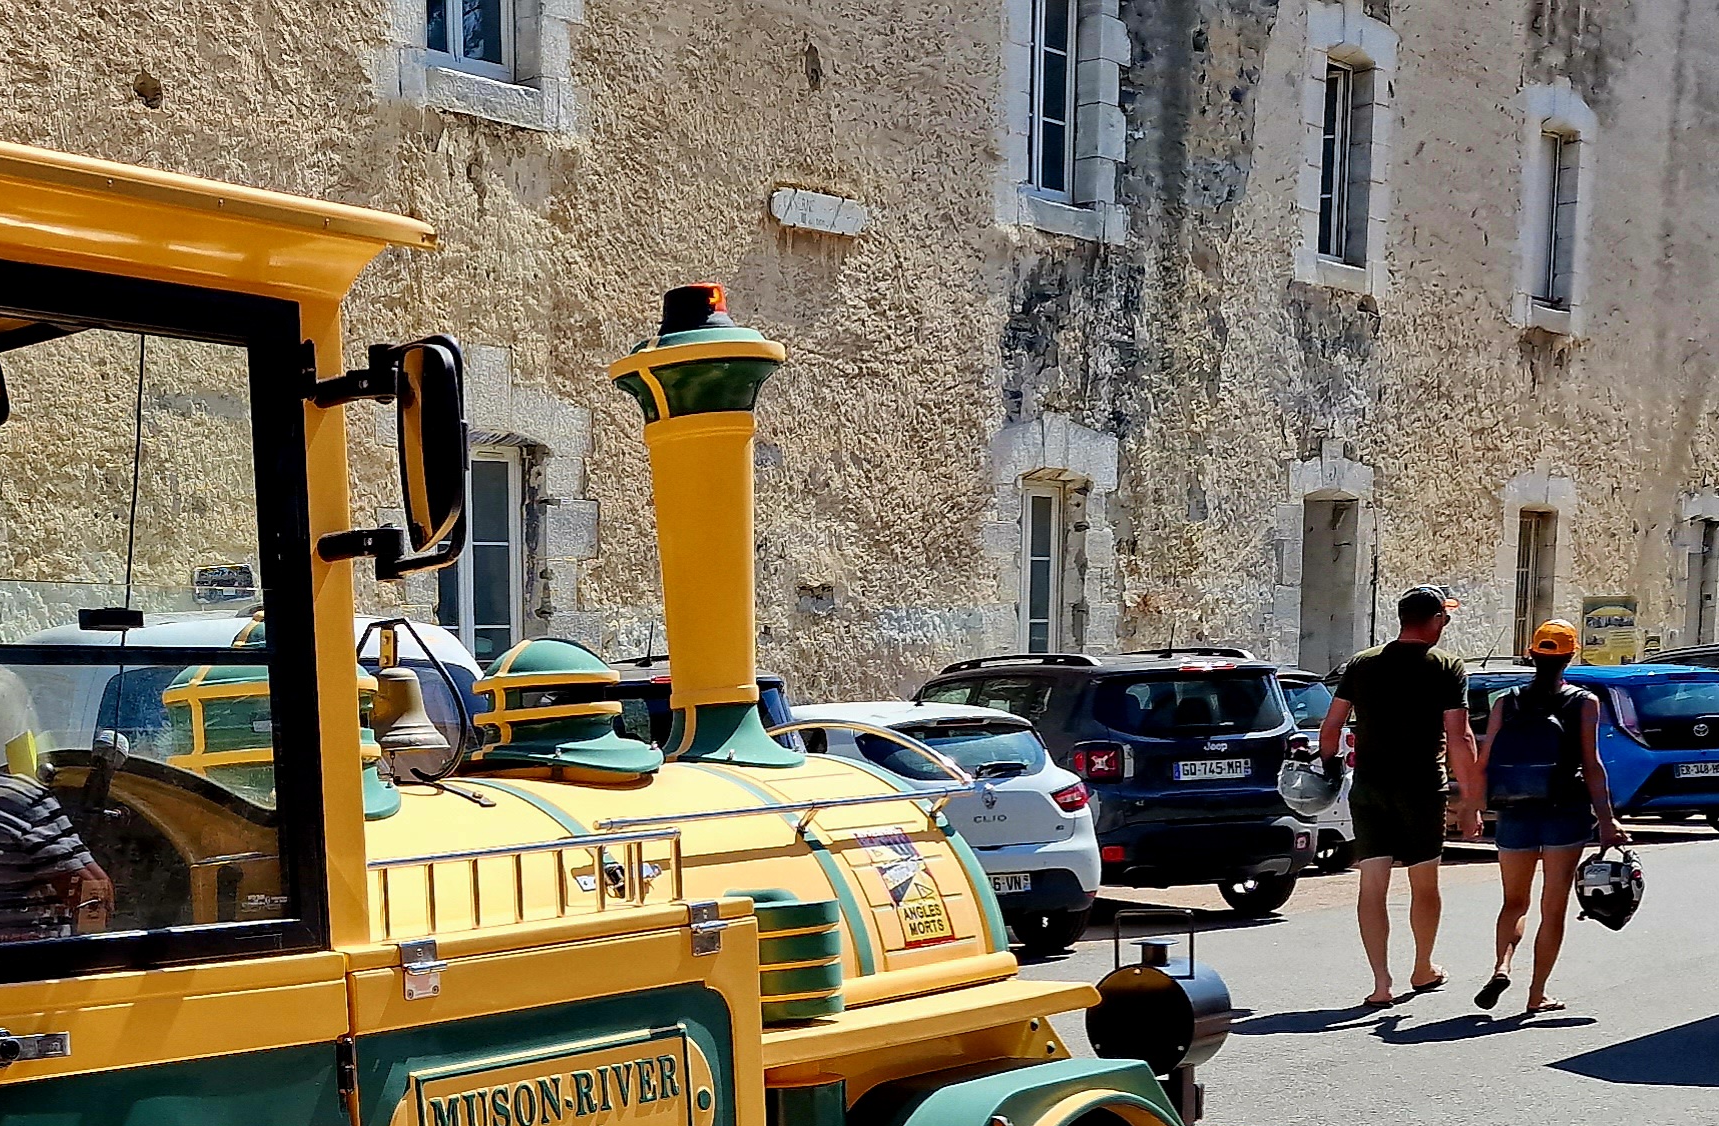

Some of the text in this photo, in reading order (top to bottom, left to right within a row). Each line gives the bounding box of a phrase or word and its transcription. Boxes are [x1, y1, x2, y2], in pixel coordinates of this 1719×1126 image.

[1203, 742, 1228, 752] Jeep
[973, 814, 1007, 823] CLIO
[903, 903, 943, 921] ANGLES
[908, 918, 945, 936] MORTS
